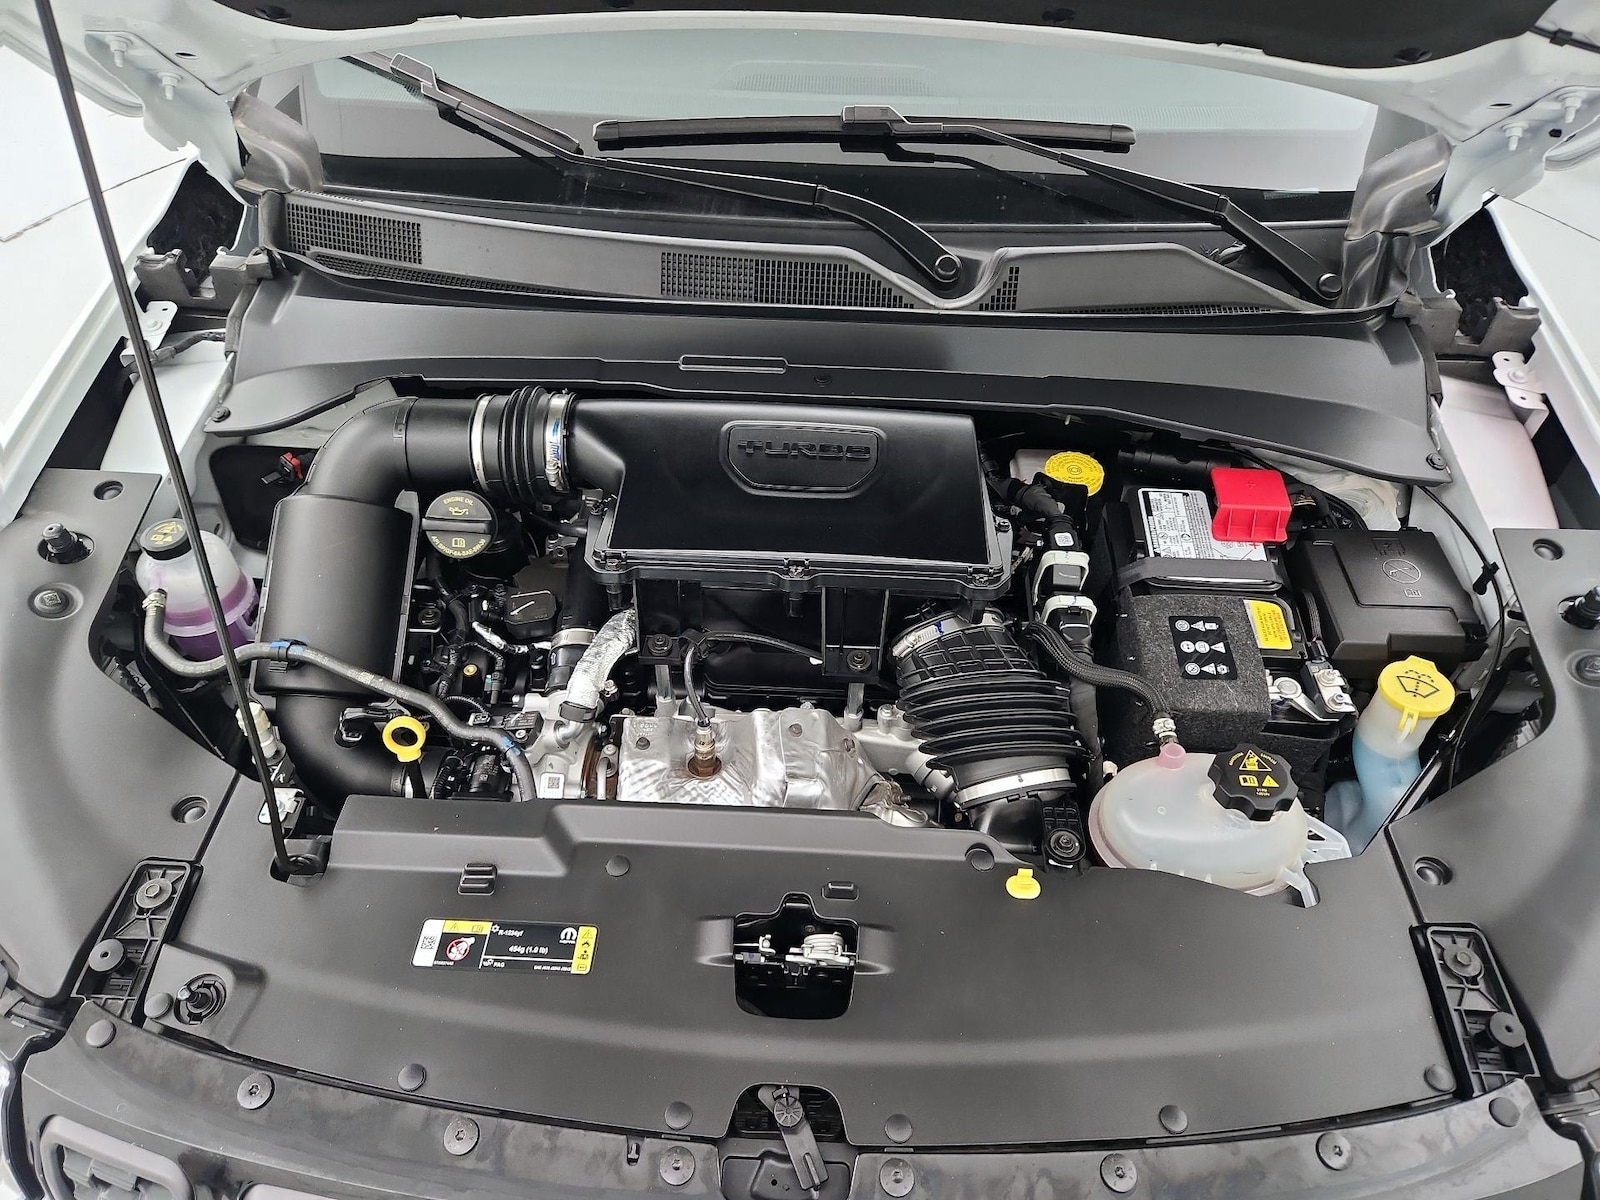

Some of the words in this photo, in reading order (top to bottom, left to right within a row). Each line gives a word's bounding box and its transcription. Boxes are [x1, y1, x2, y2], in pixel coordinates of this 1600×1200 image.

[737, 440, 870, 459] TURBO
[443, 496, 464, 505] ENGINE
[464, 498, 474, 506] OIL
[431, 535, 439, 545] API
[508, 945, 526, 955] 454g
[525, 946, 539, 955] (1.0
[539, 946, 549, 955] lb)
